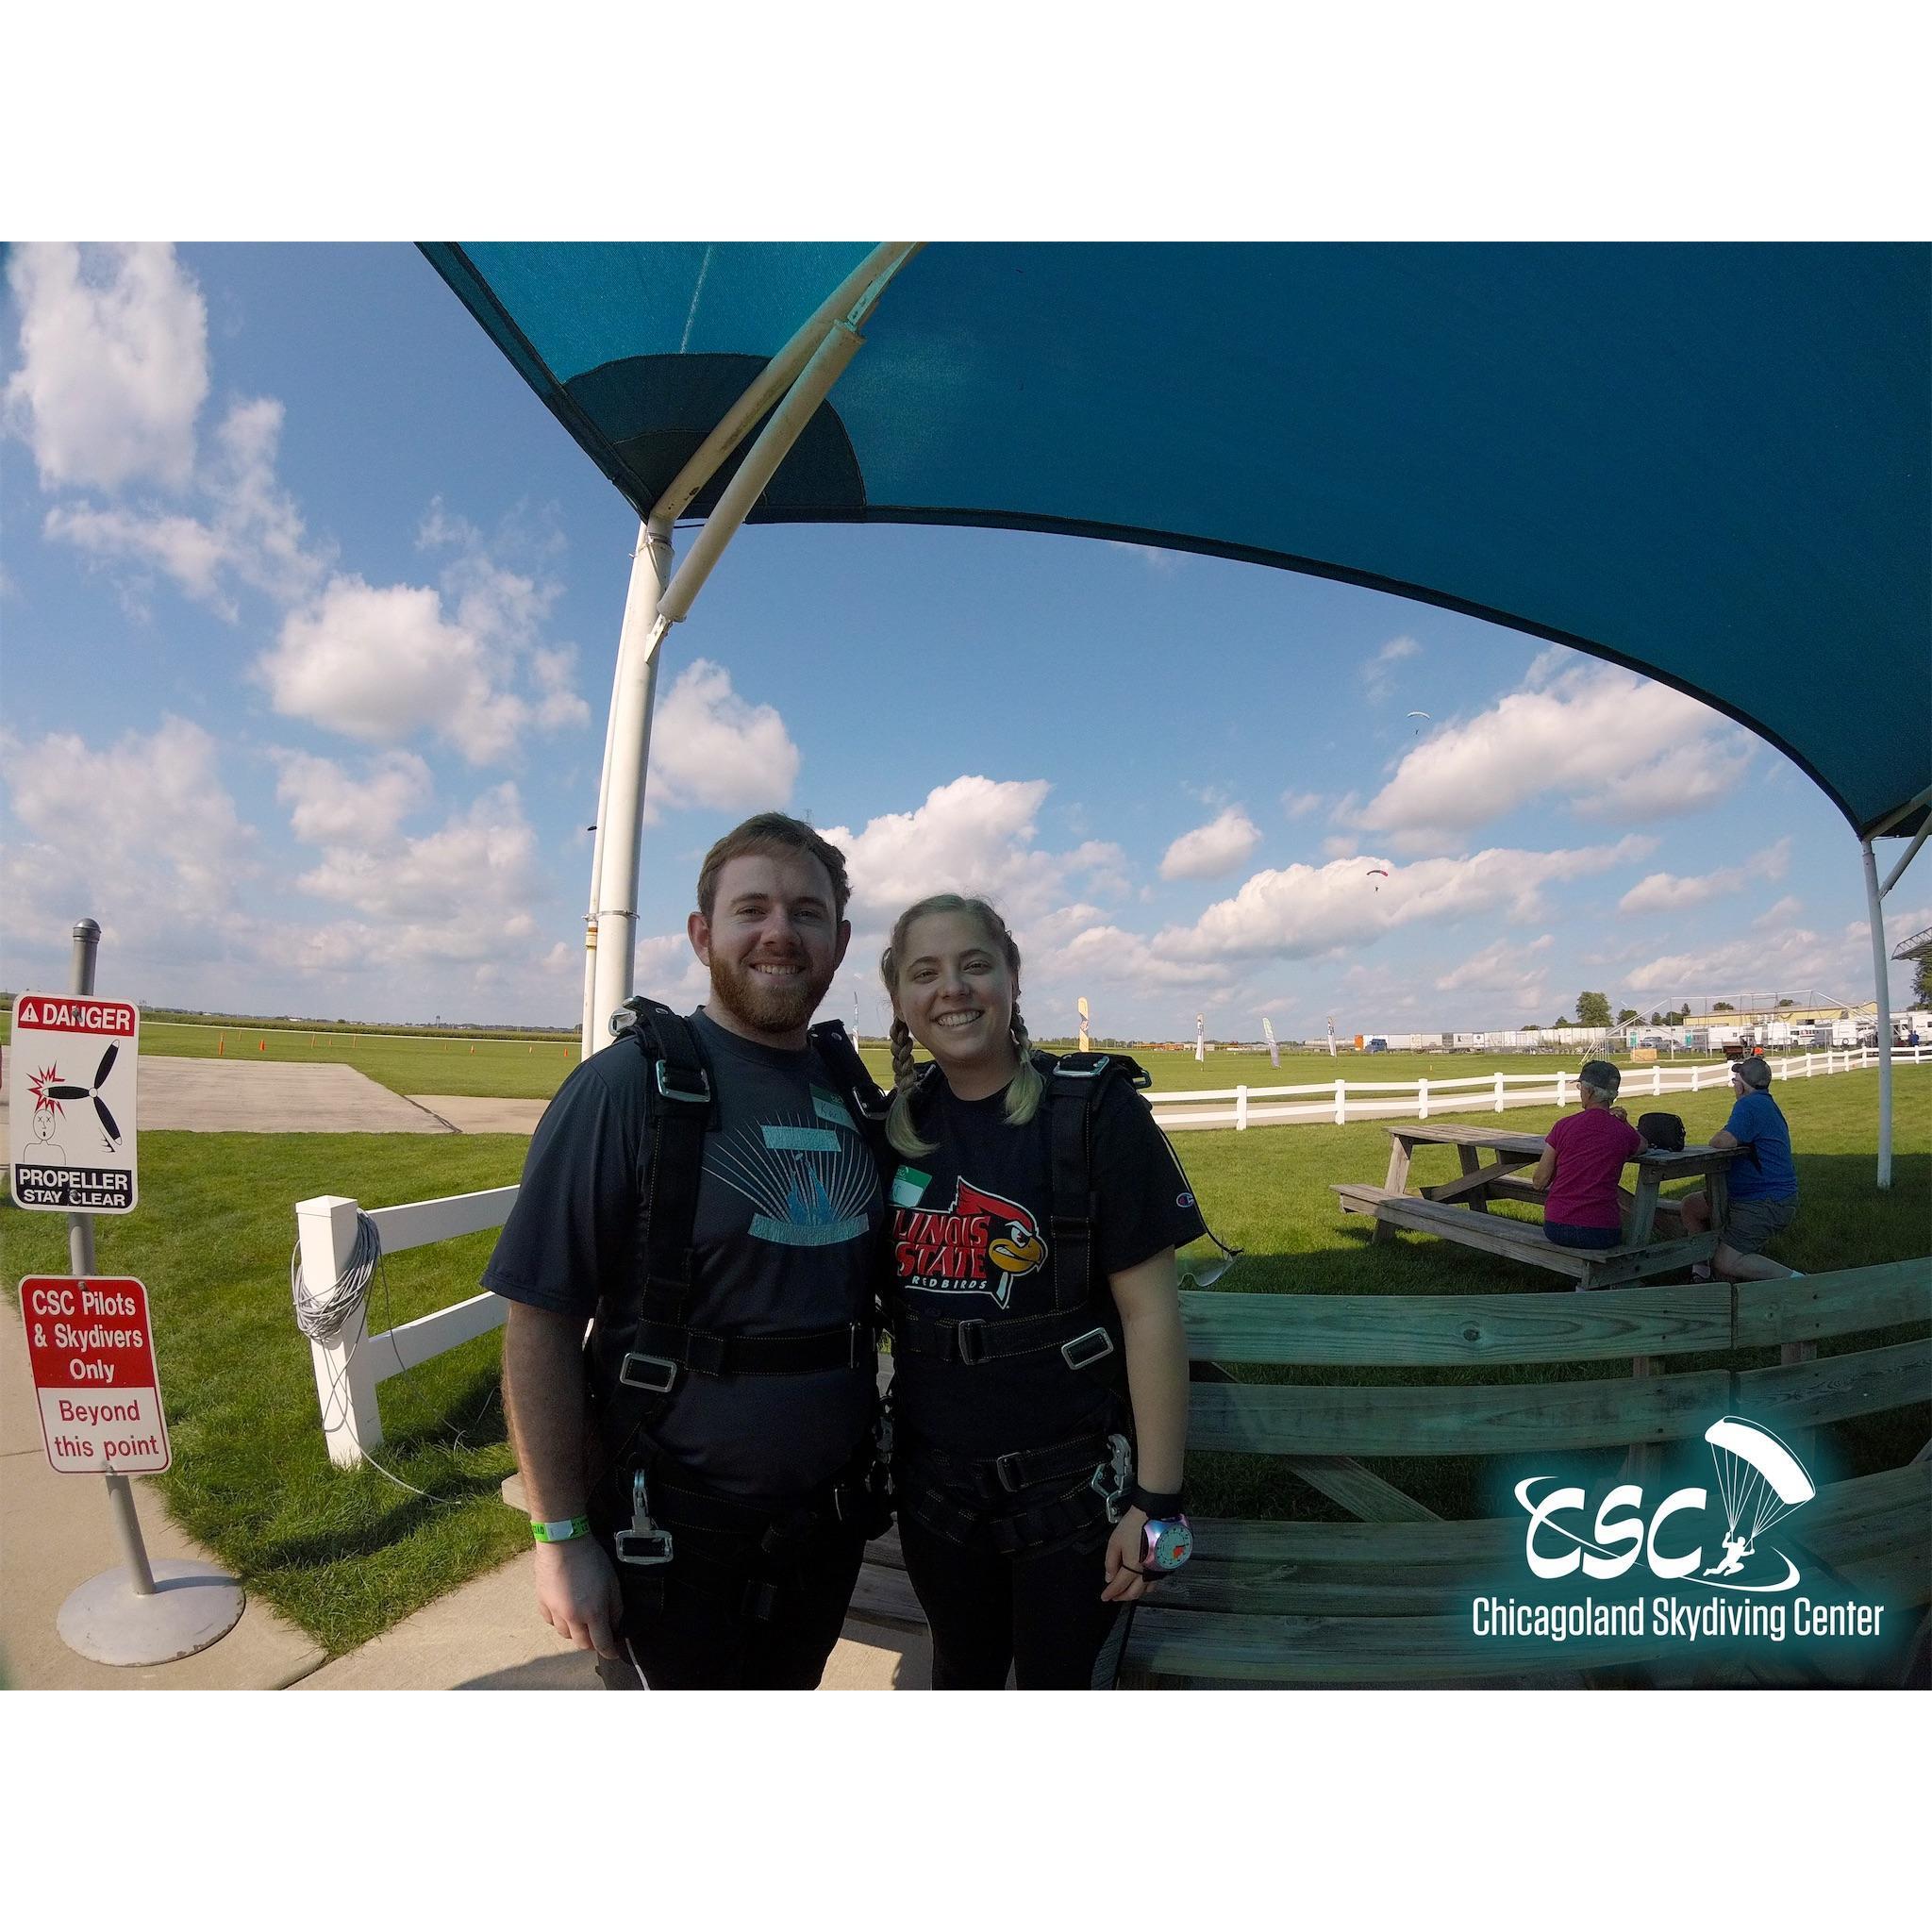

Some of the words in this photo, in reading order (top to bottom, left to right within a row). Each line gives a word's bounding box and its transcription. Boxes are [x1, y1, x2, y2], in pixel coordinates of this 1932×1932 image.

[42, 1003, 131, 1031] DANGER
[19, 1169, 128, 1191] PROPELLER
[24, 1189, 62, 1204] STAY
[69, 1190, 125, 1207] CLEAR
[895, 1241, 987, 1278] STATE
[912, 1275, 988, 1290] REDBIRDS
[32, 1290, 75, 1316] CSC
[82, 1291, 137, 1316] Pilots
[34, 1323, 48, 1348] &
[55, 1323, 143, 1353] Skydivers
[69, 1358, 115, 1384] Only
[58, 1399, 141, 1426] Beyond
[55, 1436, 94, 1457] this
[104, 1435, 159, 1461] point
